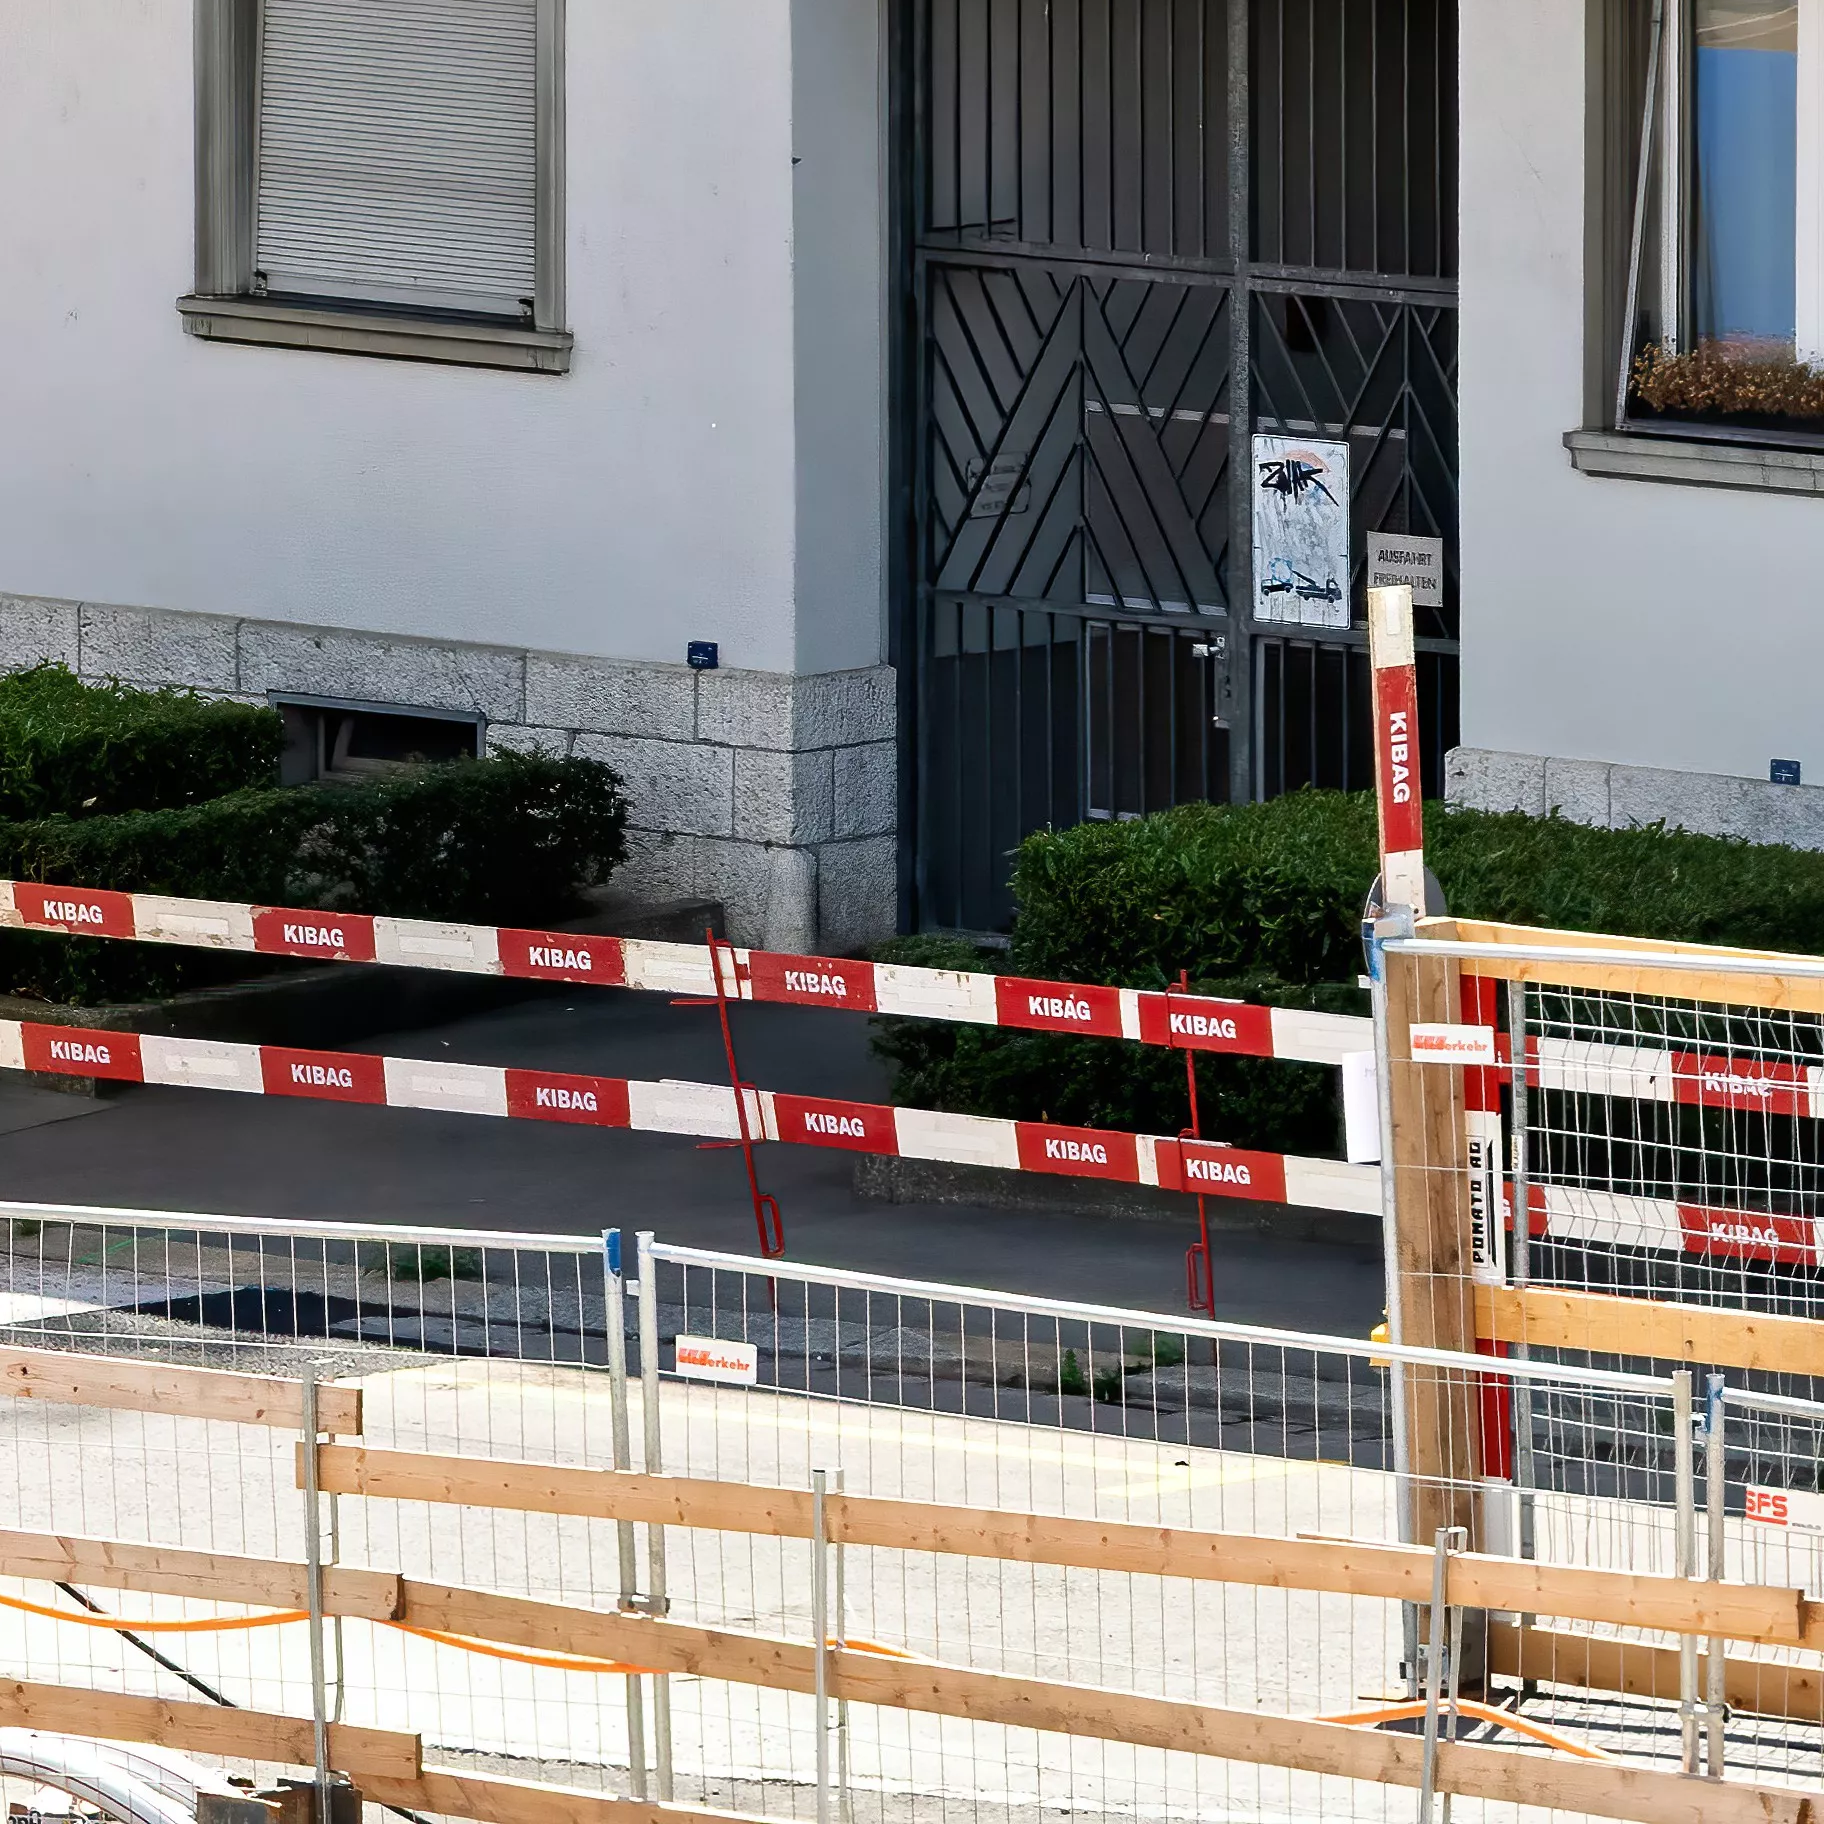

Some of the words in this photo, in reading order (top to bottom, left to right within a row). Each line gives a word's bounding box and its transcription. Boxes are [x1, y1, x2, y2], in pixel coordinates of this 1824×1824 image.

[1389, 711, 1411, 805] KIBAG
[43, 900, 103, 924] KIBAG
[283, 924, 345, 948] KIBAG
[529, 946, 592, 971] KIBAG
[784, 970, 847, 996] KIBAG
[1028, 996, 1092, 1021] KIBAG
[1169, 1013, 1237, 1039] KIBAG
[50, 1040, 111, 1064] KIBAG
[290, 1063, 353, 1088] KIBAG
[535, 1087, 598, 1112] KIBAG
[804, 1112, 865, 1138] KIBAG
[1045, 1138, 1108, 1164] KIBAG
[1186, 1158, 1251, 1185] KIBAG
[1745, 1490, 1789, 1518] SFS
